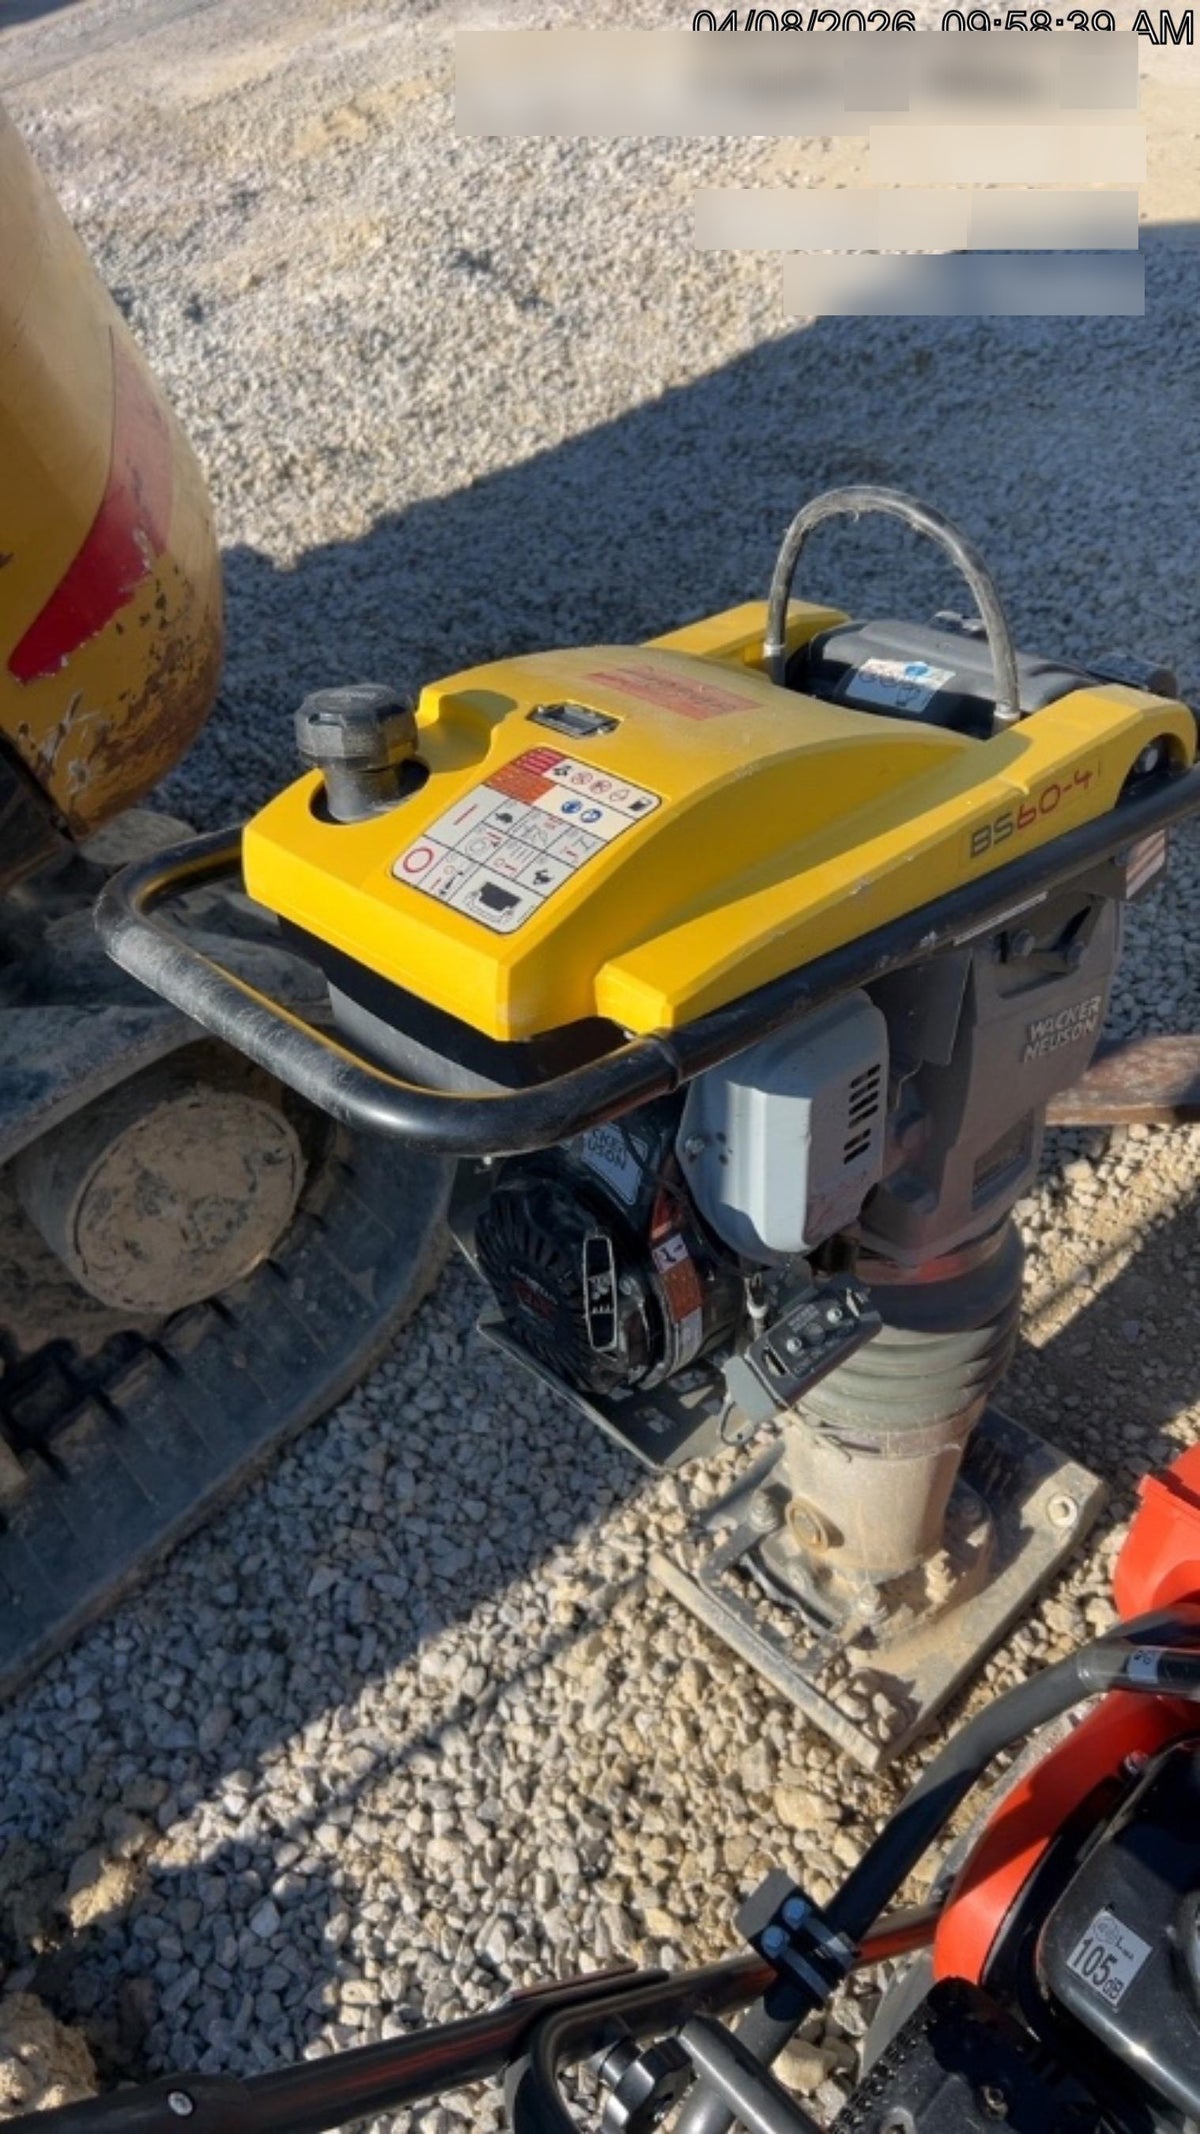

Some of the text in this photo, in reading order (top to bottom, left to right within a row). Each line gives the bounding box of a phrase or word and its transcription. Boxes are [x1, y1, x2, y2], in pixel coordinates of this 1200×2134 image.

[969, 767, 1093, 859] BS60-4
[1023, 1016, 1098, 1063] NEUSON
[1030, 995, 1101, 1041] WACKER
